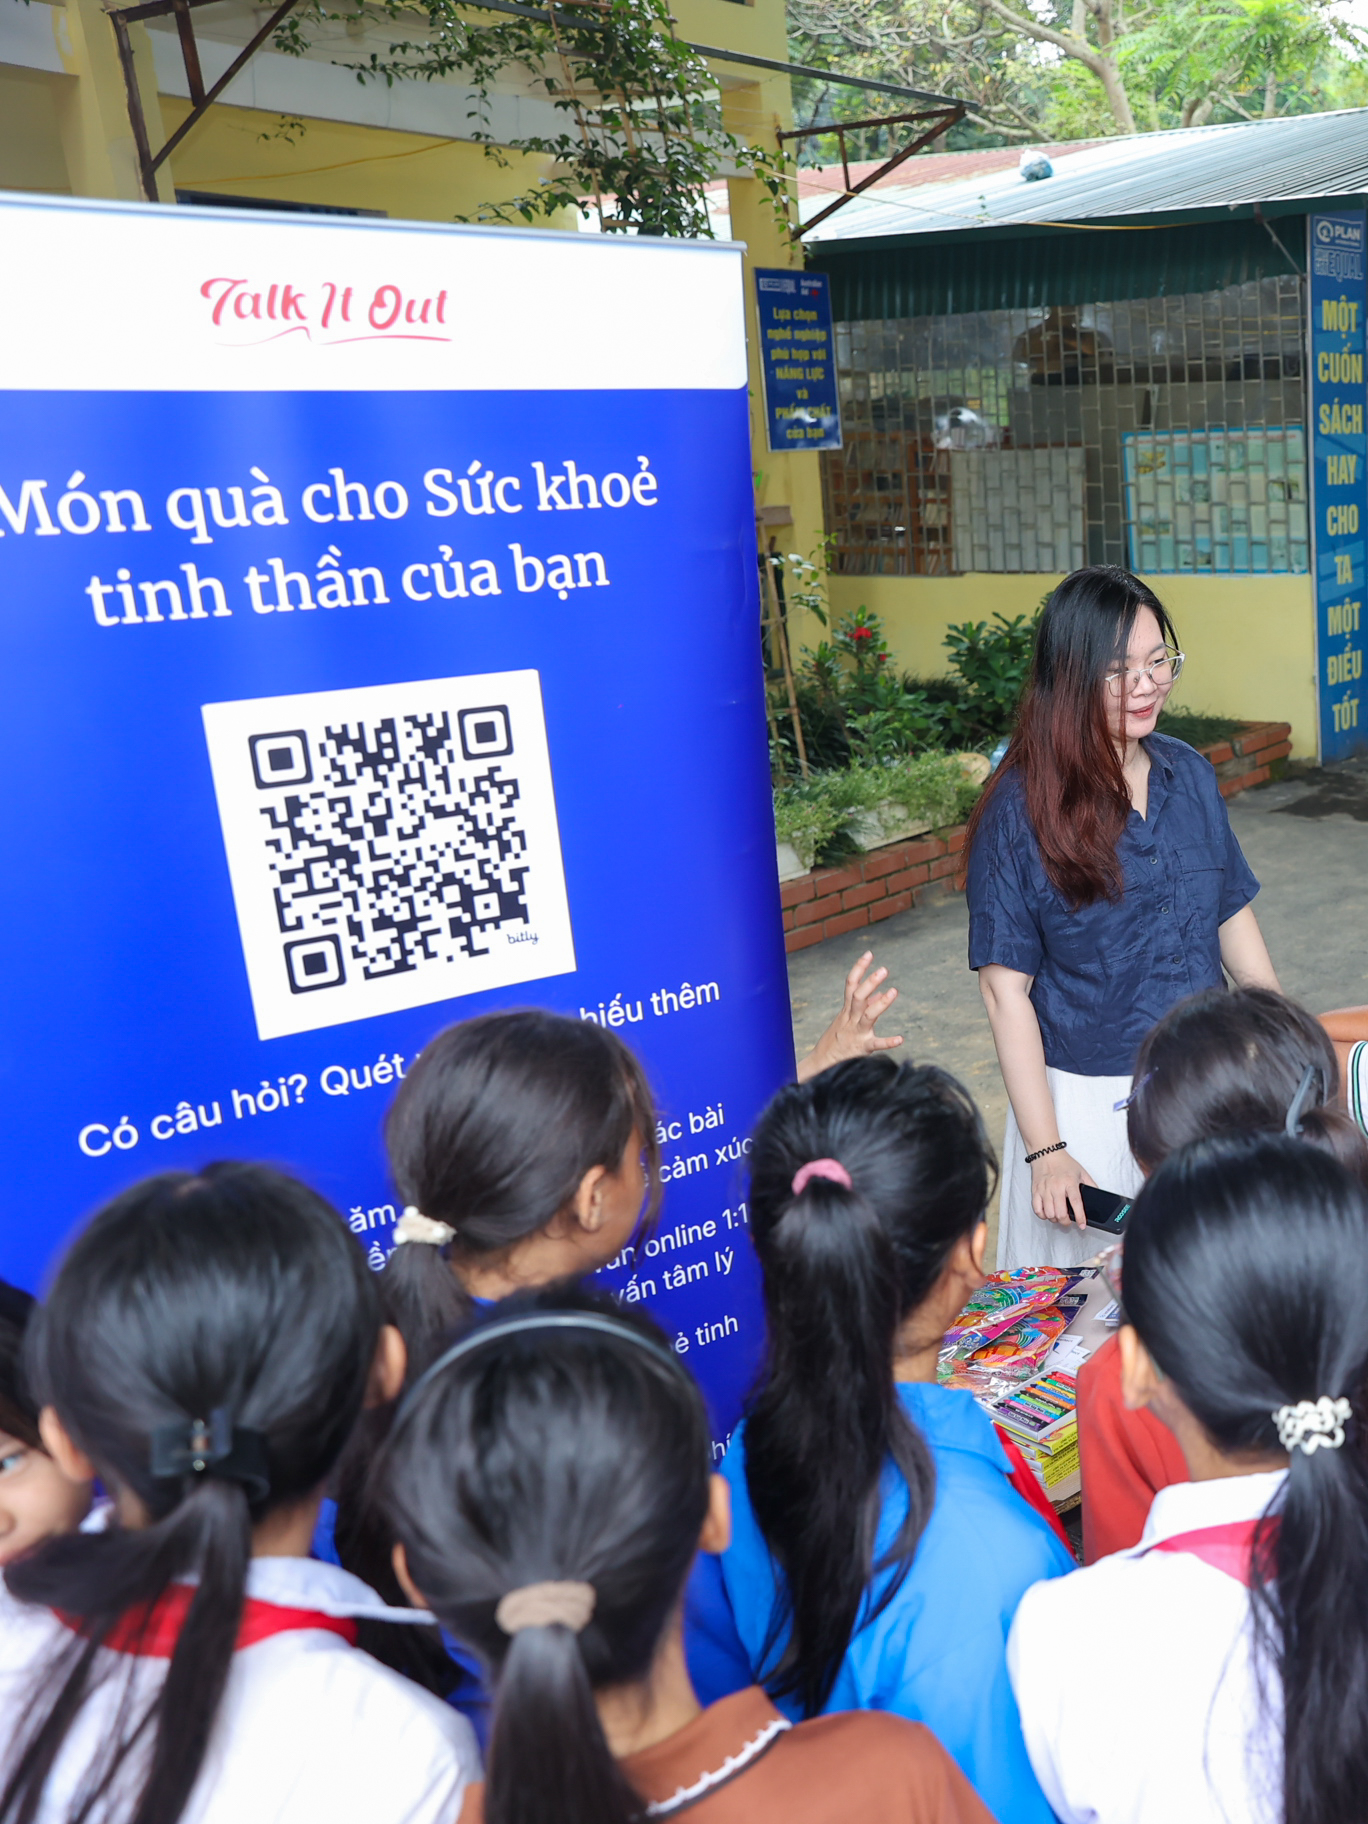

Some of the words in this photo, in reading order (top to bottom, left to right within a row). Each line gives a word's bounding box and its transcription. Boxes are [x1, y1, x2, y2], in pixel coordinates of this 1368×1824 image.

[1335, 225, 1361, 240] PLAN
[200, 277, 308, 326] Talk
[321, 282, 353, 329] It
[368, 284, 448, 330] Out
[1322, 295, 1358, 338] MỘT
[1318, 342, 1363, 383] CUỐN
[1319, 397, 1363, 434] SÁCH
[1326, 454, 1358, 485] HAY
[0, 469, 152, 538] Món
[166, 465, 289, 544] quà
[301, 467, 409, 523] cho
[423, 459, 523, 517] Sức
[531, 455, 658, 511] khoẻ
[1326, 504, 1359, 536] CHO
[85, 562, 233, 627] tinh
[243, 544, 390, 614] thần
[402, 544, 502, 602] của
[507, 542, 611, 601] bạn
[1334, 554, 1354, 585] TA
[1327, 597, 1362, 639] MỘT
[1332, 690, 1360, 732] TỐT
[506, 930, 539, 945] bitly
[78, 1116, 139, 1157] Có
[150, 1101, 223, 1140] câu
[231, 1073, 308, 1119] hỏi?
[320, 1053, 407, 1096] Quét
[650, 982, 720, 1016] thêm
[655, 1121, 683, 1145] ác
[688, 1103, 725, 1134] bài
[658, 1156, 709, 1183] cảm
[715, 1136, 753, 1166] xúc
[349, 1204, 397, 1233] ăm
[645, 1219, 717, 1257] online
[722, 1203, 749, 1230] 1:1
[611, 1274, 657, 1305] vấn
[662, 1261, 709, 1290] tâm
[715, 1246, 734, 1275] lý
[695, 1314, 739, 1346] tinh
